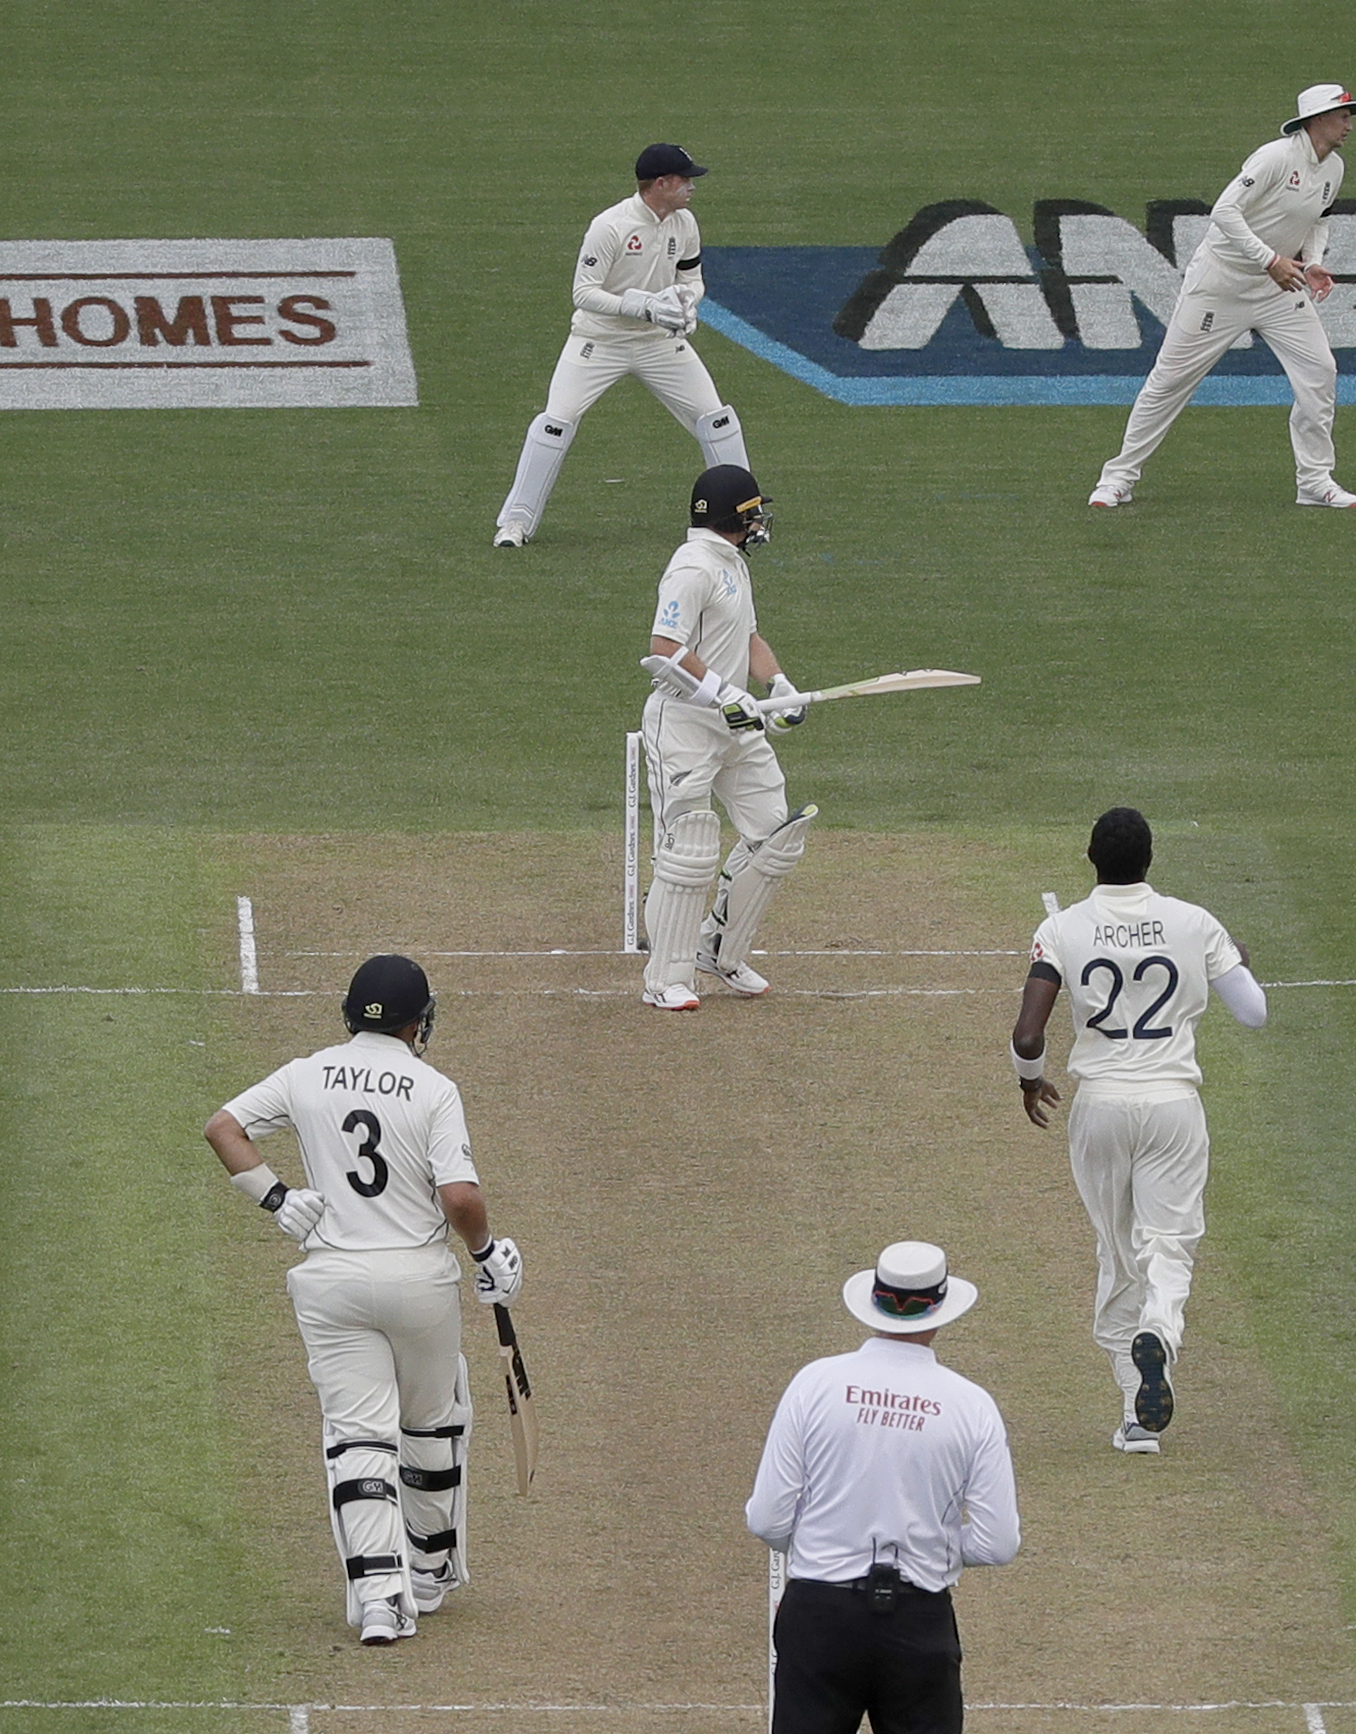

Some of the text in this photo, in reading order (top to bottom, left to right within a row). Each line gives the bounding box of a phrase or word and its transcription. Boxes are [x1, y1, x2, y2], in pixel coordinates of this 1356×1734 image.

[0, 294, 336, 347] HOMES
[1093, 920, 1166, 948] ARCHER
[1080, 956, 1179, 1039] 22
[322, 1065, 414, 1101] TAYLOR
[341, 1109, 388, 1198] 3
[846, 1385, 941, 1416] Emirates
[857, 1408, 926, 1432] FLY BETTER
